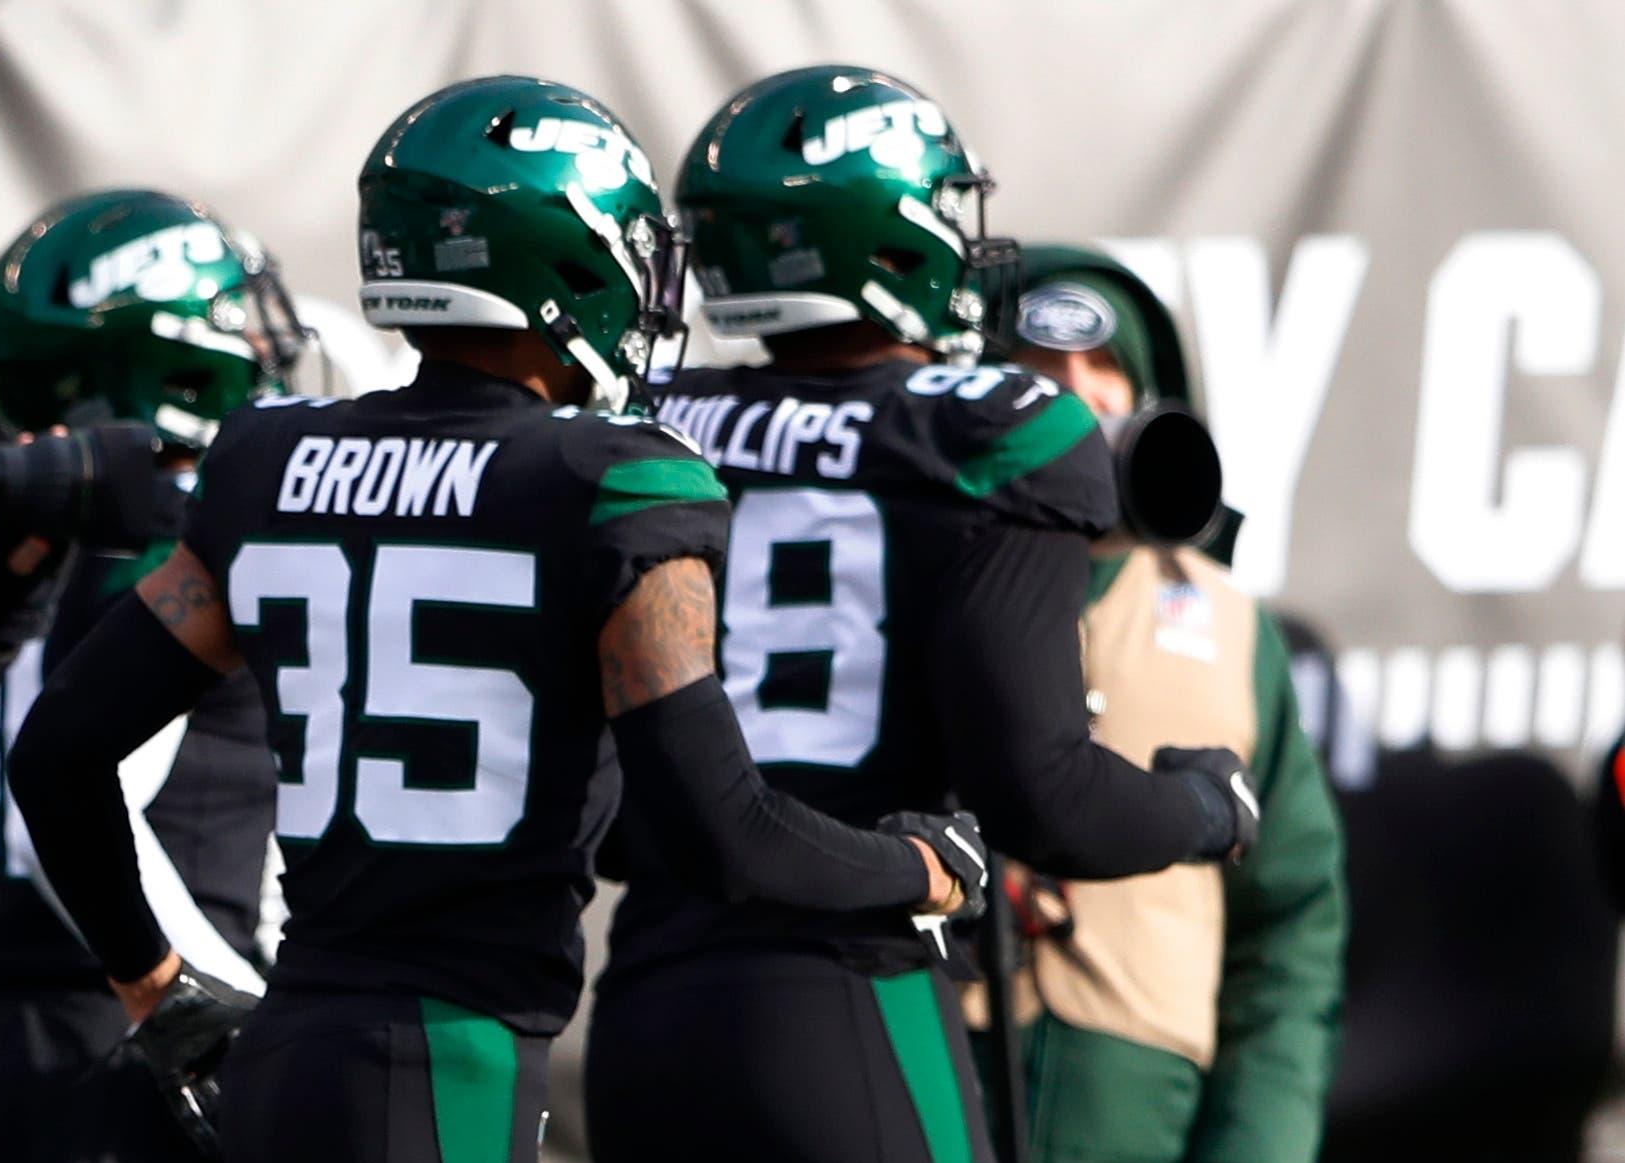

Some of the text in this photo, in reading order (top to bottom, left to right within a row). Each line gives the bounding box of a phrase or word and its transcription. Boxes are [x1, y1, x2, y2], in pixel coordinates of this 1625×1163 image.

[277, 436, 498, 517] BROWN
[1409, 230, 1625, 595] C
[228, 543, 536, 844] 35
